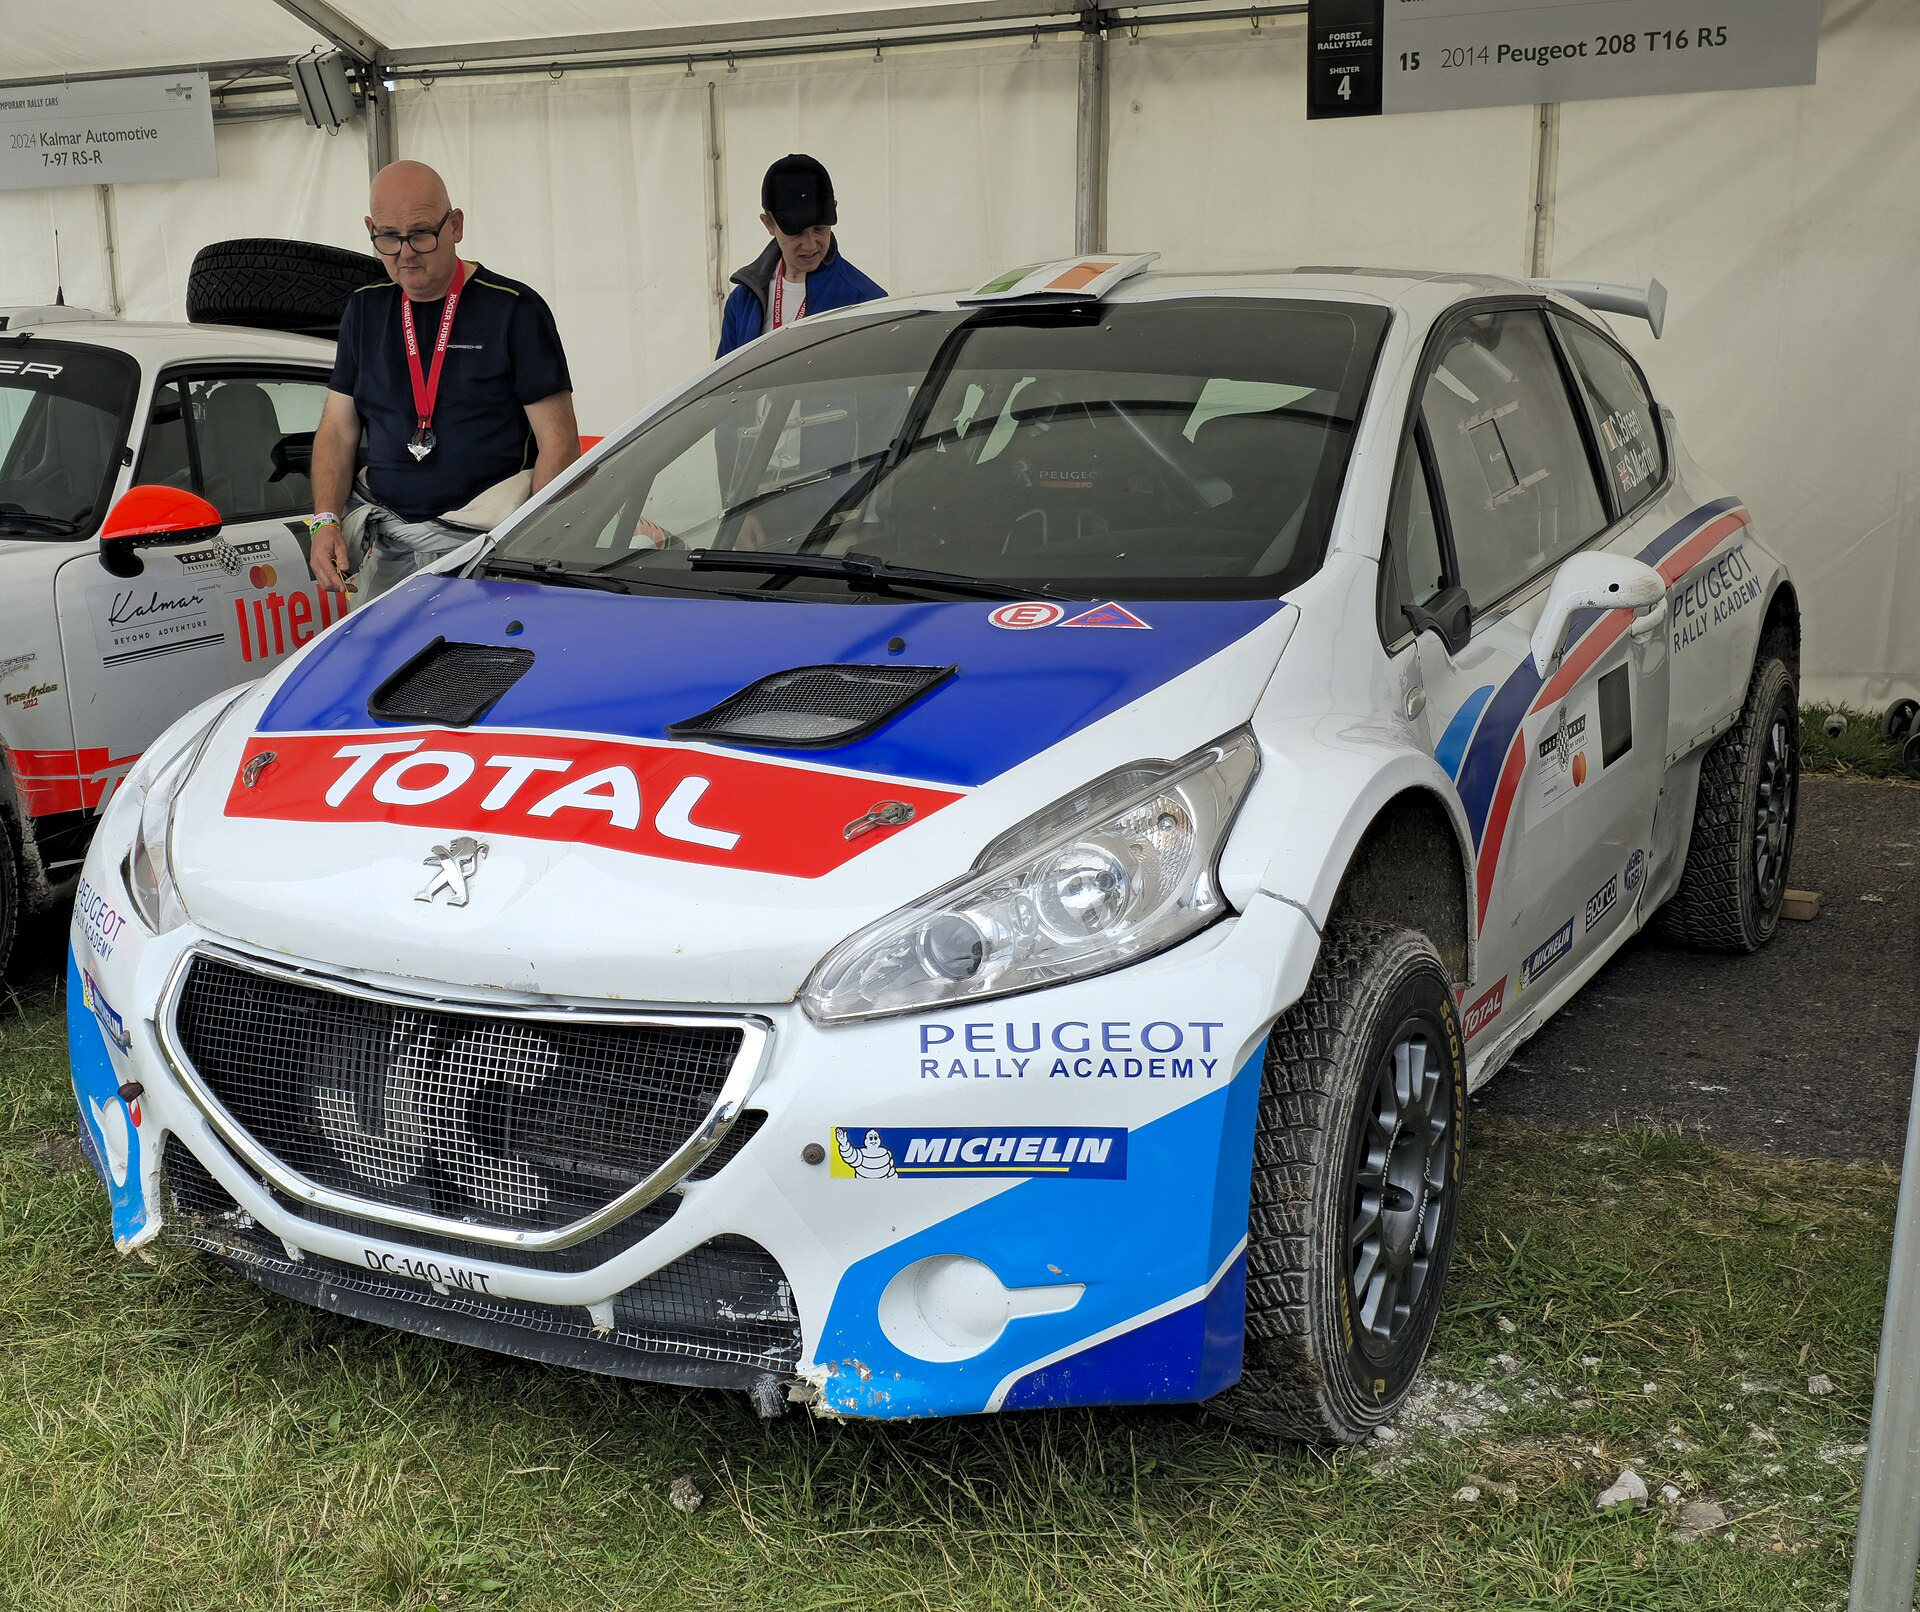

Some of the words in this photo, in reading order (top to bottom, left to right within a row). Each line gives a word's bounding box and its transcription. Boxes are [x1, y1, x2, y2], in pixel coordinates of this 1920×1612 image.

[1317, 41, 1344, 50] RALLY
[1345, 38, 1373, 48] STAGE
[1329, 31, 1362, 41] FOREST
[1400, 51, 1420, 71] 15
[1440, 45, 1490, 69] 2014
[1496, 40, 1588, 66] Peugeot
[1594, 33, 1637, 56] 208
[1643, 29, 1689, 52] T16
[1697, 25, 1728, 48] R5
[1329, 65, 1360, 75] SHELTER
[1337, 75, 1352, 101] 4
[26, 98, 44, 108] RALLY
[44, 97, 59, 107] CARS
[10, 133, 37, 149] 2024
[39, 131, 82, 147] Kalmar
[85, 125, 158, 144] Automotive
[41, 151, 68, 167] 7-97
[71, 150, 103, 166] RS-R
[444, 293, 458, 321] ROGER
[437, 321, 450, 352] DUBUIS
[182, 552, 212, 563] GOOD
[239, 542, 269, 553] WOOD
[187, 561, 219, 572] FESTIVAL
[252, 552, 272, 561] SPEED
[1673, 544, 1752, 628] PEUGEOT
[108, 590, 204, 627] Kalmar
[1673, 611, 1708, 655] RALLY
[1713, 575, 1763, 626] ACADEMY
[114, 632, 150, 646] BEYOND
[158, 620, 208, 637] ADVENTURE
[22, 697, 39, 710] 2022
[323, 738, 742, 851] TOTAL
[78, 878, 127, 942] PEUGEOT
[1586, 877, 1617, 924] sparco
[1531, 924, 1572, 973] MICHELIN
[1463, 991, 1502, 1037] TOTAL
[919, 1021, 1224, 1054] PEUGEOT
[920, 1057, 1030, 1079] RALLY
[1048, 1057, 1219, 1079] ACADEMY
[1439, 999, 1463, 1184] SCORPION
[903, 1137, 1115, 1164] MICHELIN
[364, 1249, 490, 1294] DC-140-WT
